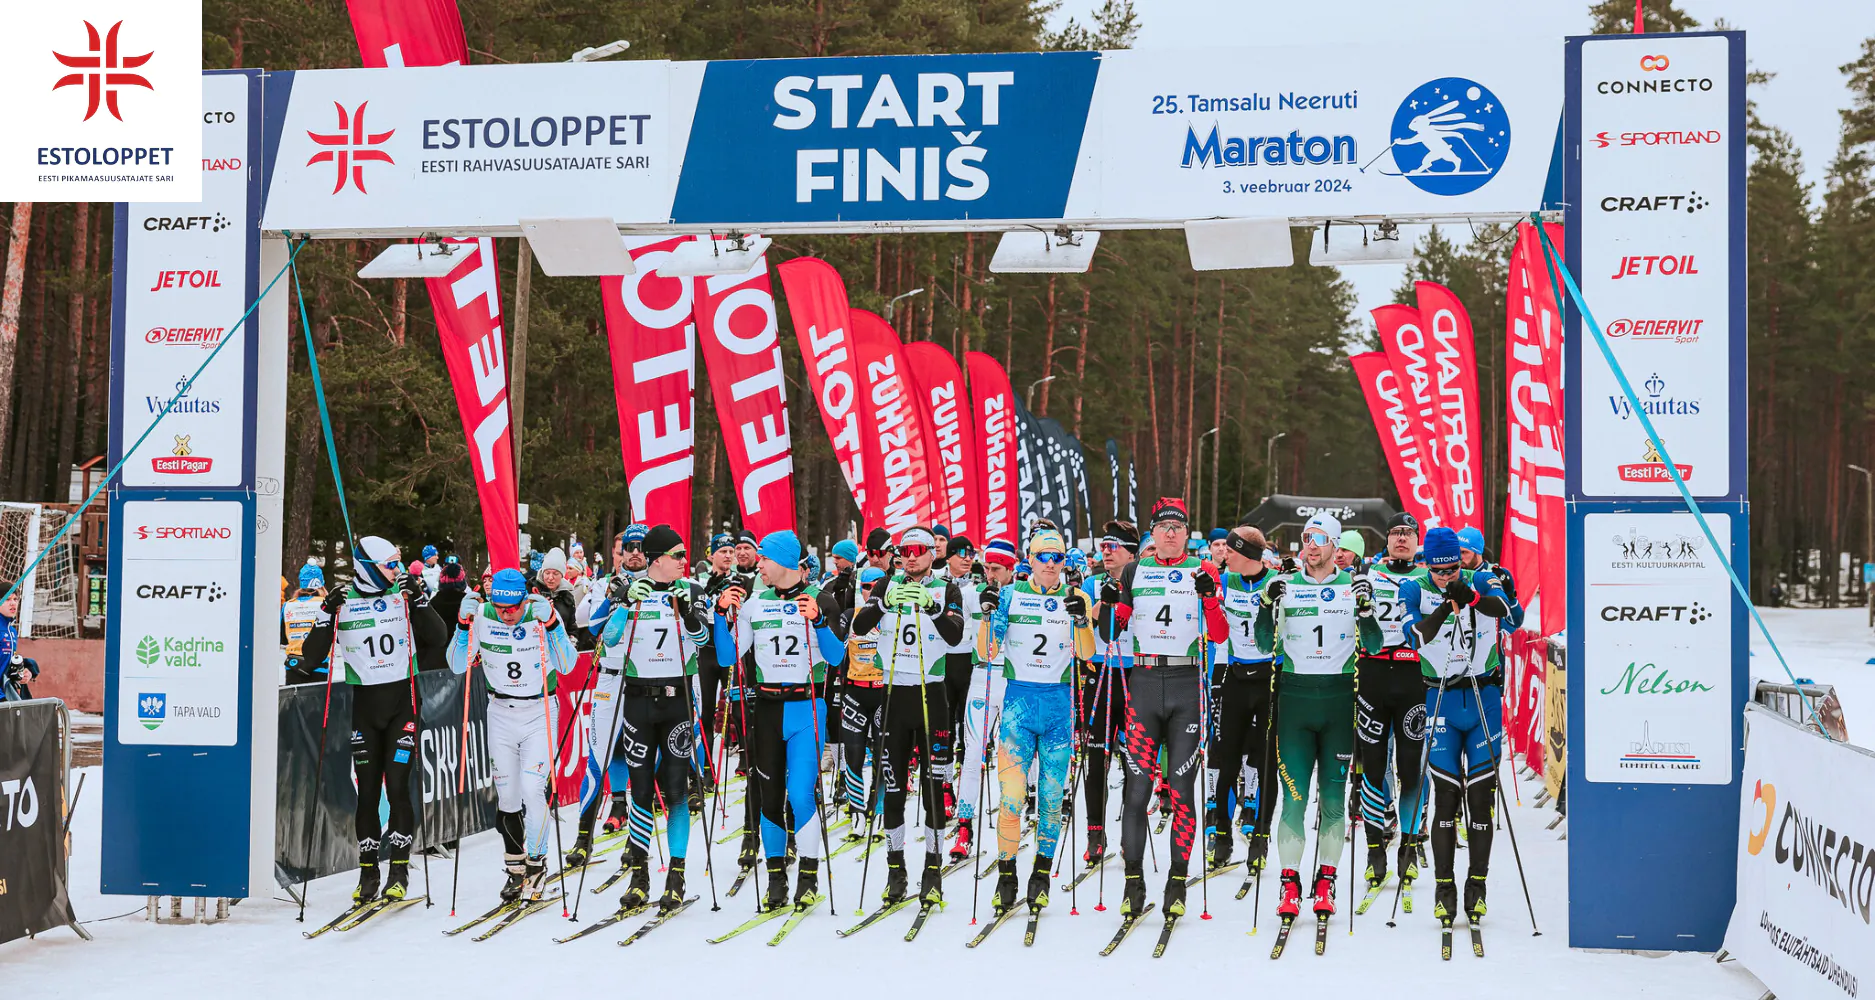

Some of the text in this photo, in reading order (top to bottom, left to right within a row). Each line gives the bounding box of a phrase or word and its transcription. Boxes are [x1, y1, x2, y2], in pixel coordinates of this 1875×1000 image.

[1597, 78, 1713, 94] CONNECTO
[773, 71, 1014, 130] START
[1152, 90, 1358, 114] 25. Tamsalu Neeruti
[422, 114, 651, 150] ESTOLOPPET
[1620, 130, 1721, 146] SPORTLAND
[1180, 119, 1359, 169] Maraton
[421, 155, 650, 174] EESTI RAHVASUUSATAJATE SARI
[796, 130, 990, 203] FINIŠ
[1222, 179, 1352, 194] 3. veebruar 2024
[1600, 196, 1685, 212] CRAFT
[143, 216, 212, 232] CRAFT
[1611, 255, 1699, 280] JETOIL
[150, 269, 222, 292] JETOIL
[166, 326, 225, 344] ENERVIT
[1632, 319, 1704, 336] ENERVIT
[1674, 335, 1700, 344] Sport
[1609, 395, 1701, 420] Vyautas
[156, 458, 209, 474] Eesti Pagar
[1624, 466, 1652, 479] Eesti
[156, 525, 232, 541] SPORTLAND
[1611, 561, 1706, 569] EESTI KULTUURKAPITAL
[136, 583, 208, 600] CRAFT
[1155, 604, 1172, 626] 4
[1600, 606, 1687, 622] CRAFT
[163, 635, 224, 654] Kadrina
[654, 628, 668, 650] 7
[903, 624, 917, 646] 6
[1032, 633, 1048, 656] 2
[1312, 624, 1323, 648] 1
[363, 634, 394, 658] 10
[770, 635, 800, 656] 12
[164, 650, 202, 668] vald.
[506, 662, 522, 680] 8
[1600, 662, 1715, 695] Nelson
[172, 705, 221, 719] TAPA VALD
[420, 725, 458, 804] SKY
[1774, 801, 1875, 925] CONNECTO
